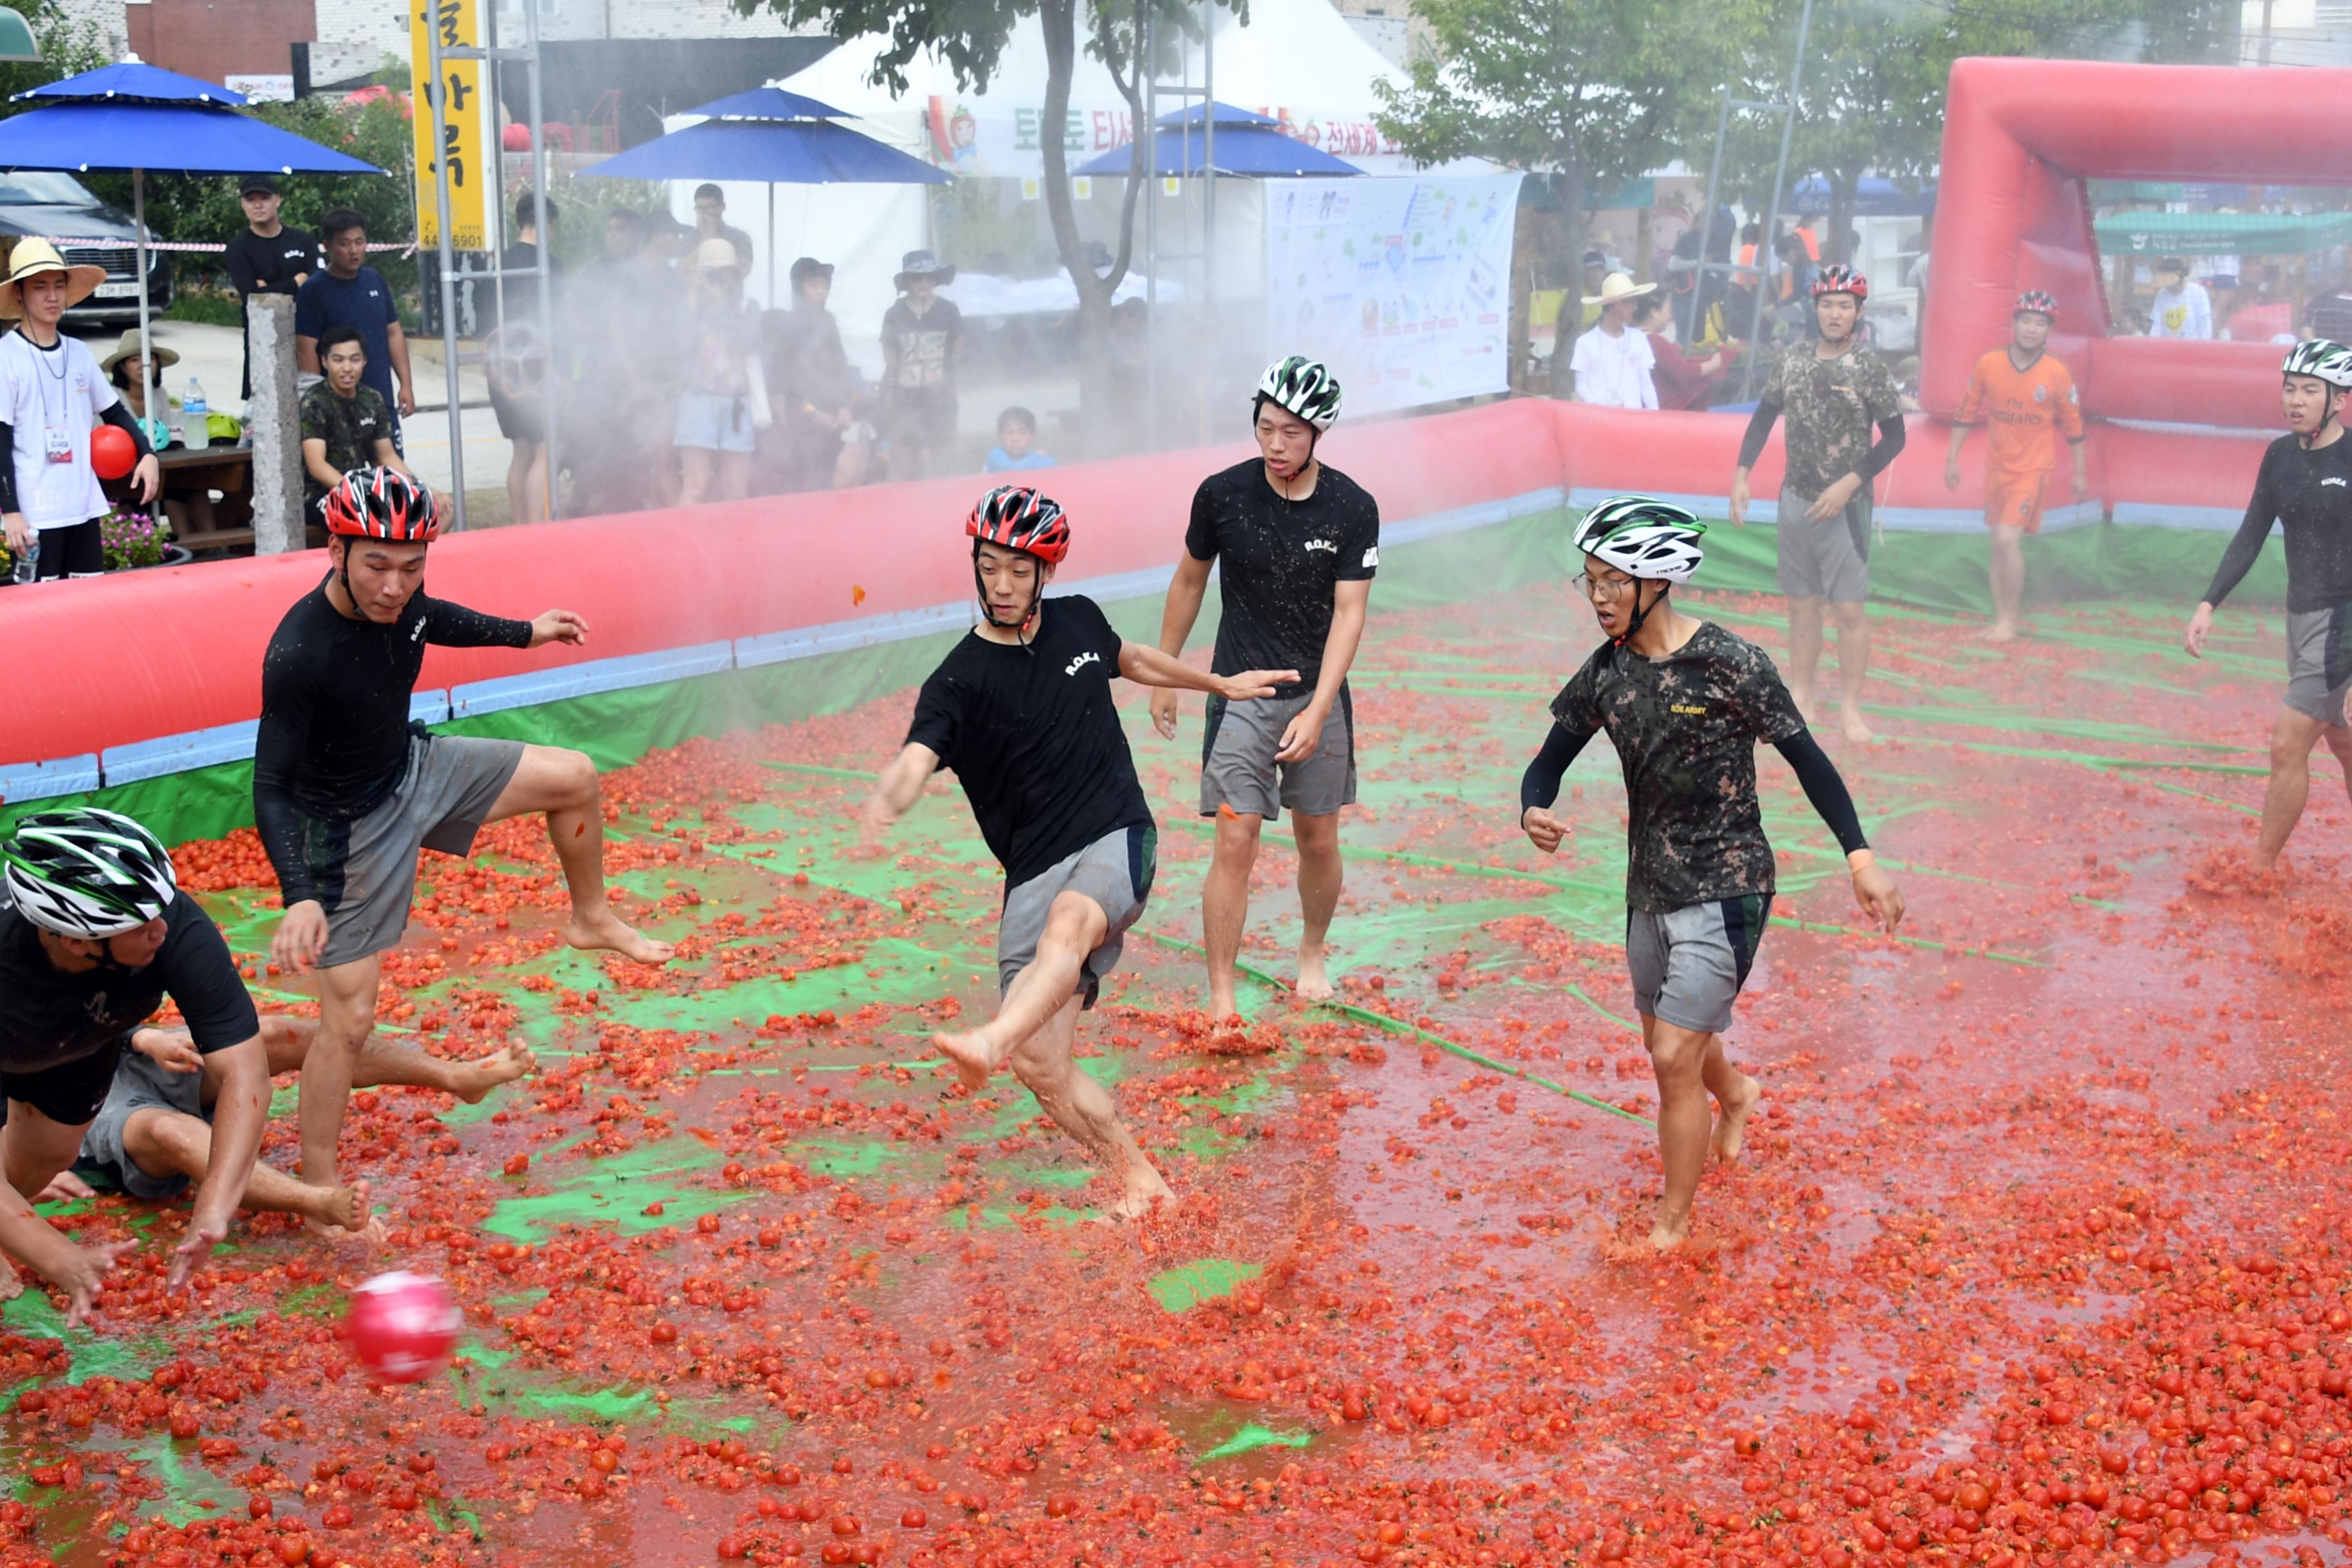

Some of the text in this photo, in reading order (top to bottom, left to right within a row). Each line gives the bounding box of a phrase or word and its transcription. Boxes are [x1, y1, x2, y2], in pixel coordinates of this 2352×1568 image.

[1014, 108, 1084, 150] 토토
[2006, 397, 2024, 409] Fly
[1685, 706, 1707, 715] ARMY
